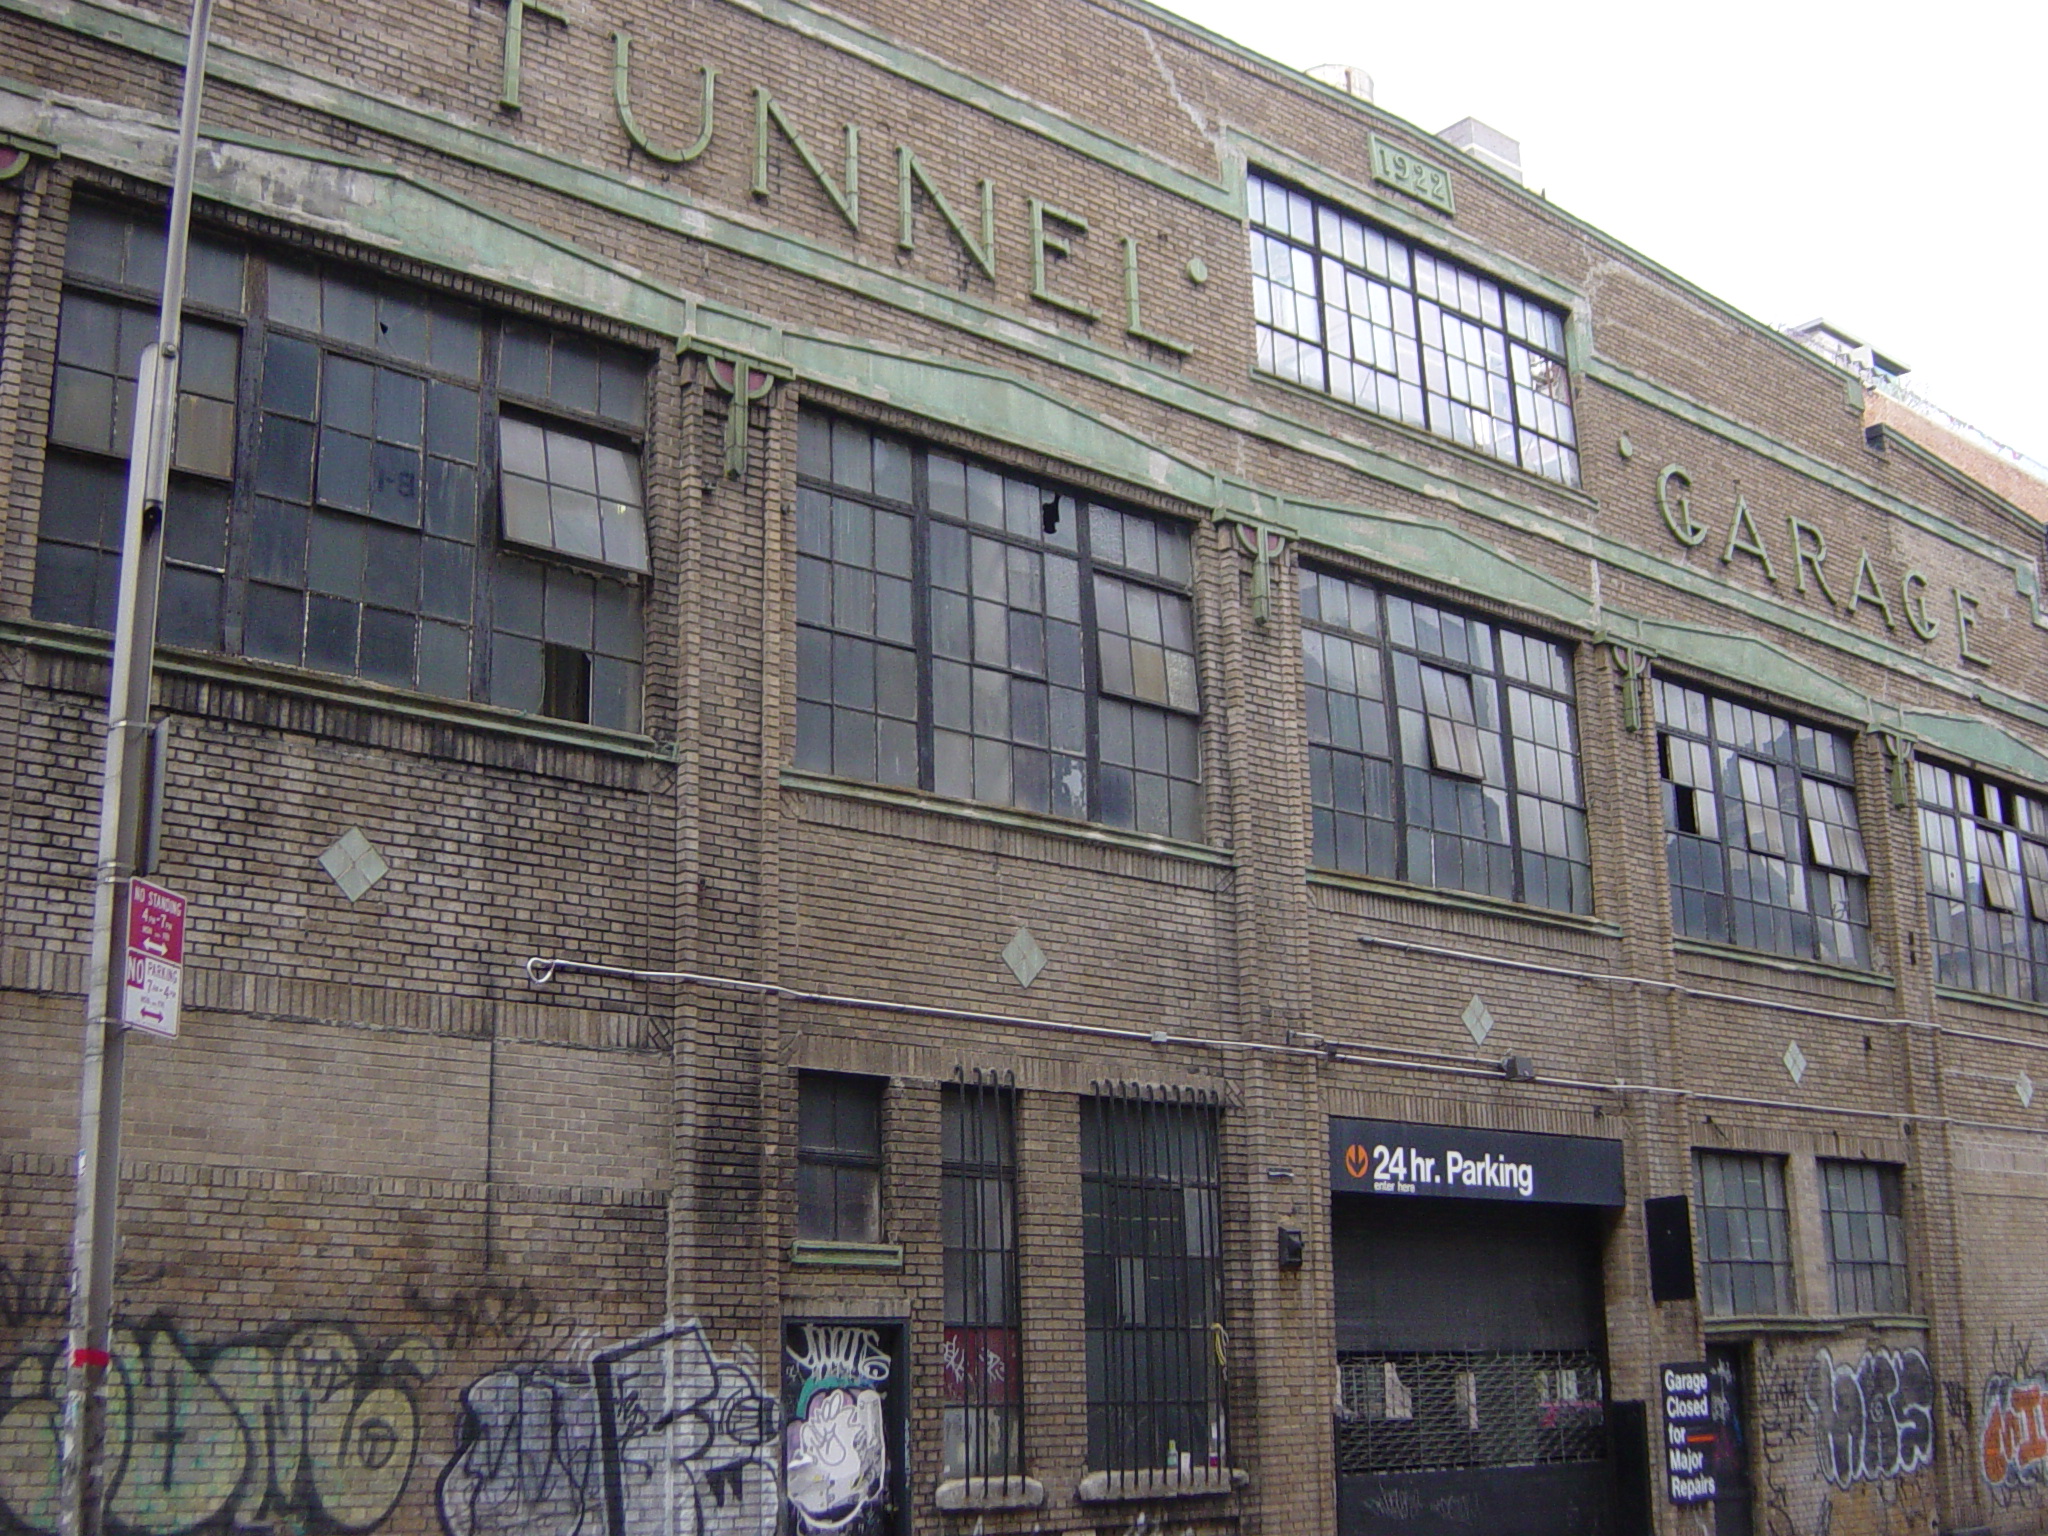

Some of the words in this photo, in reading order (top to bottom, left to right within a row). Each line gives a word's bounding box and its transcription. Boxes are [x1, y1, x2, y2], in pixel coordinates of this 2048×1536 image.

[496, 0, 1194, 358] TUNNEL
[1378, 147, 1446, 203] 1922
[1656, 462, 1993, 668] GARAGE
[134, 885, 146, 903] NO
[147, 890, 182, 917] STANDING
[127, 955, 144, 985] NO
[147, 961, 178, 985] PARKING
[1373, 1144, 1407, 1181] 24
[1410, 1147, 1441, 1184] hr.
[1446, 1150, 1533, 1197] Parking
[1373, 1180, 1396, 1192] enter
[1397, 1180, 1416, 1194] here
[1664, 1368, 1708, 1395] Garage
[1666, 1394, 1709, 1418] Closed
[1668, 1422, 1686, 1445] for
[1669, 1447, 1703, 1474] Major
[1671, 1472, 1716, 1501] Repairs
